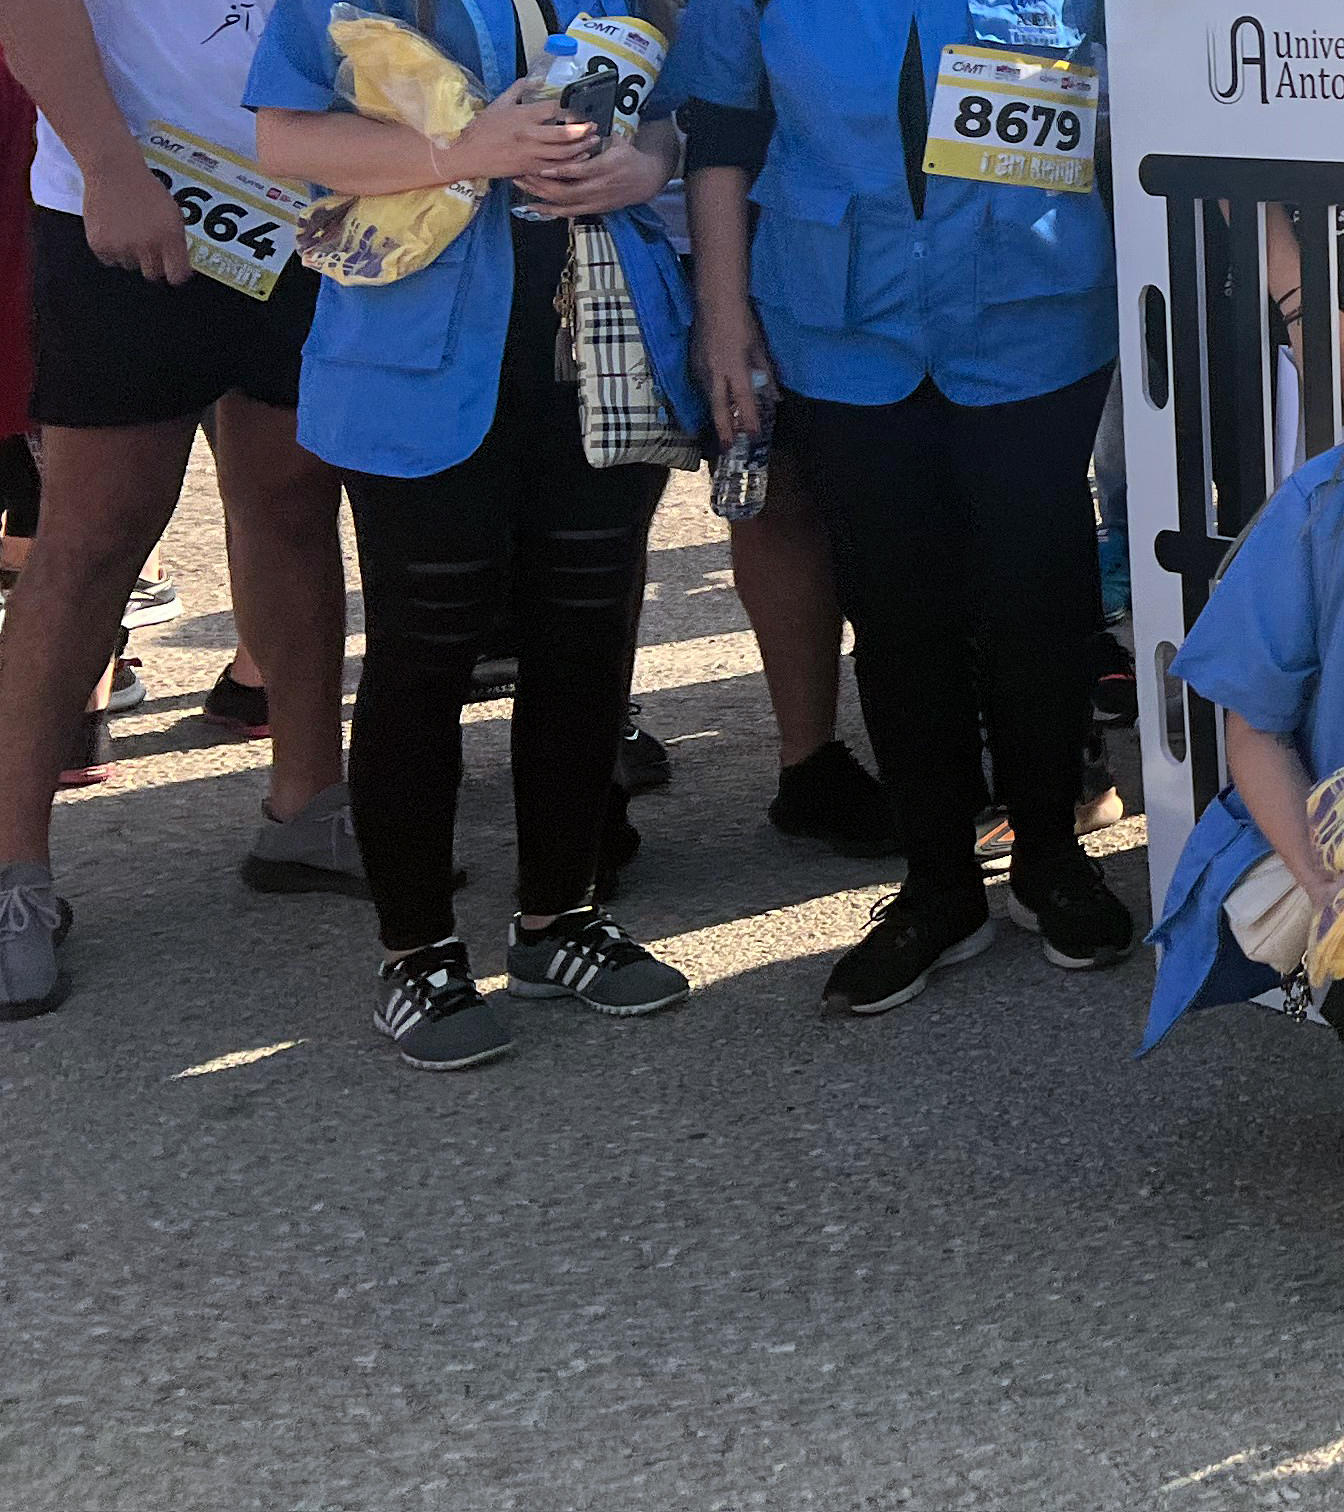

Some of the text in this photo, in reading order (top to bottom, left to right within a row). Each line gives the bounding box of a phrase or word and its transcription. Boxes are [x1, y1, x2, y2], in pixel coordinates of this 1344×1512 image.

[583, 21, 620, 35] OMT
[952, 61, 987, 75] OMT
[954, 95, 1081, 152] 8679
[150, 136, 184, 152] OMT
